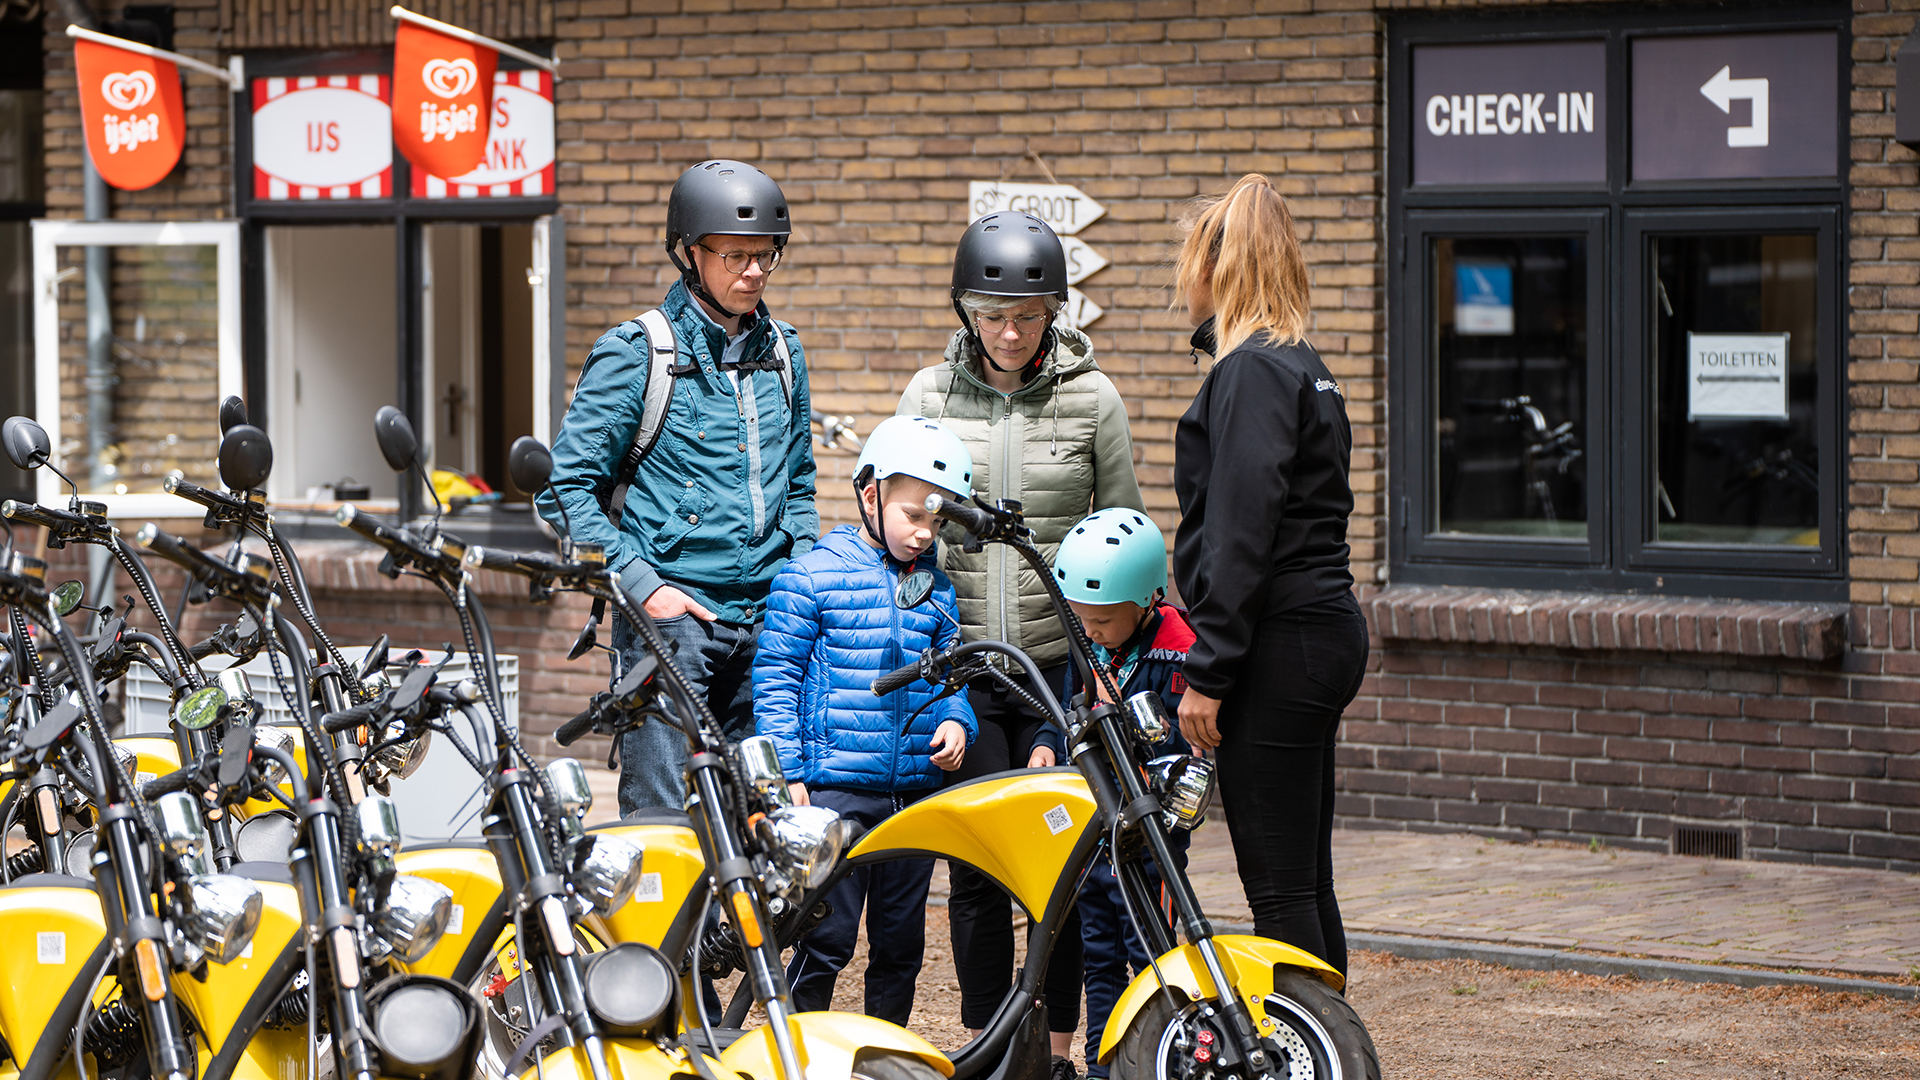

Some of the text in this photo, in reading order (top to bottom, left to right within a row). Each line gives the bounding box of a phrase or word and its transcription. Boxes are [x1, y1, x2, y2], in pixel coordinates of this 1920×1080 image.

[419, 101, 478, 143] ijsje?
[1425, 91, 1594, 137] CHECK-IN
[103, 113, 159, 154] ijsje?
[307, 121, 341, 153] IJS
[478, 138, 528, 170] ANK
[974, 188, 1008, 216] OOK
[1698, 351, 1777, 367] TOILETTEN
